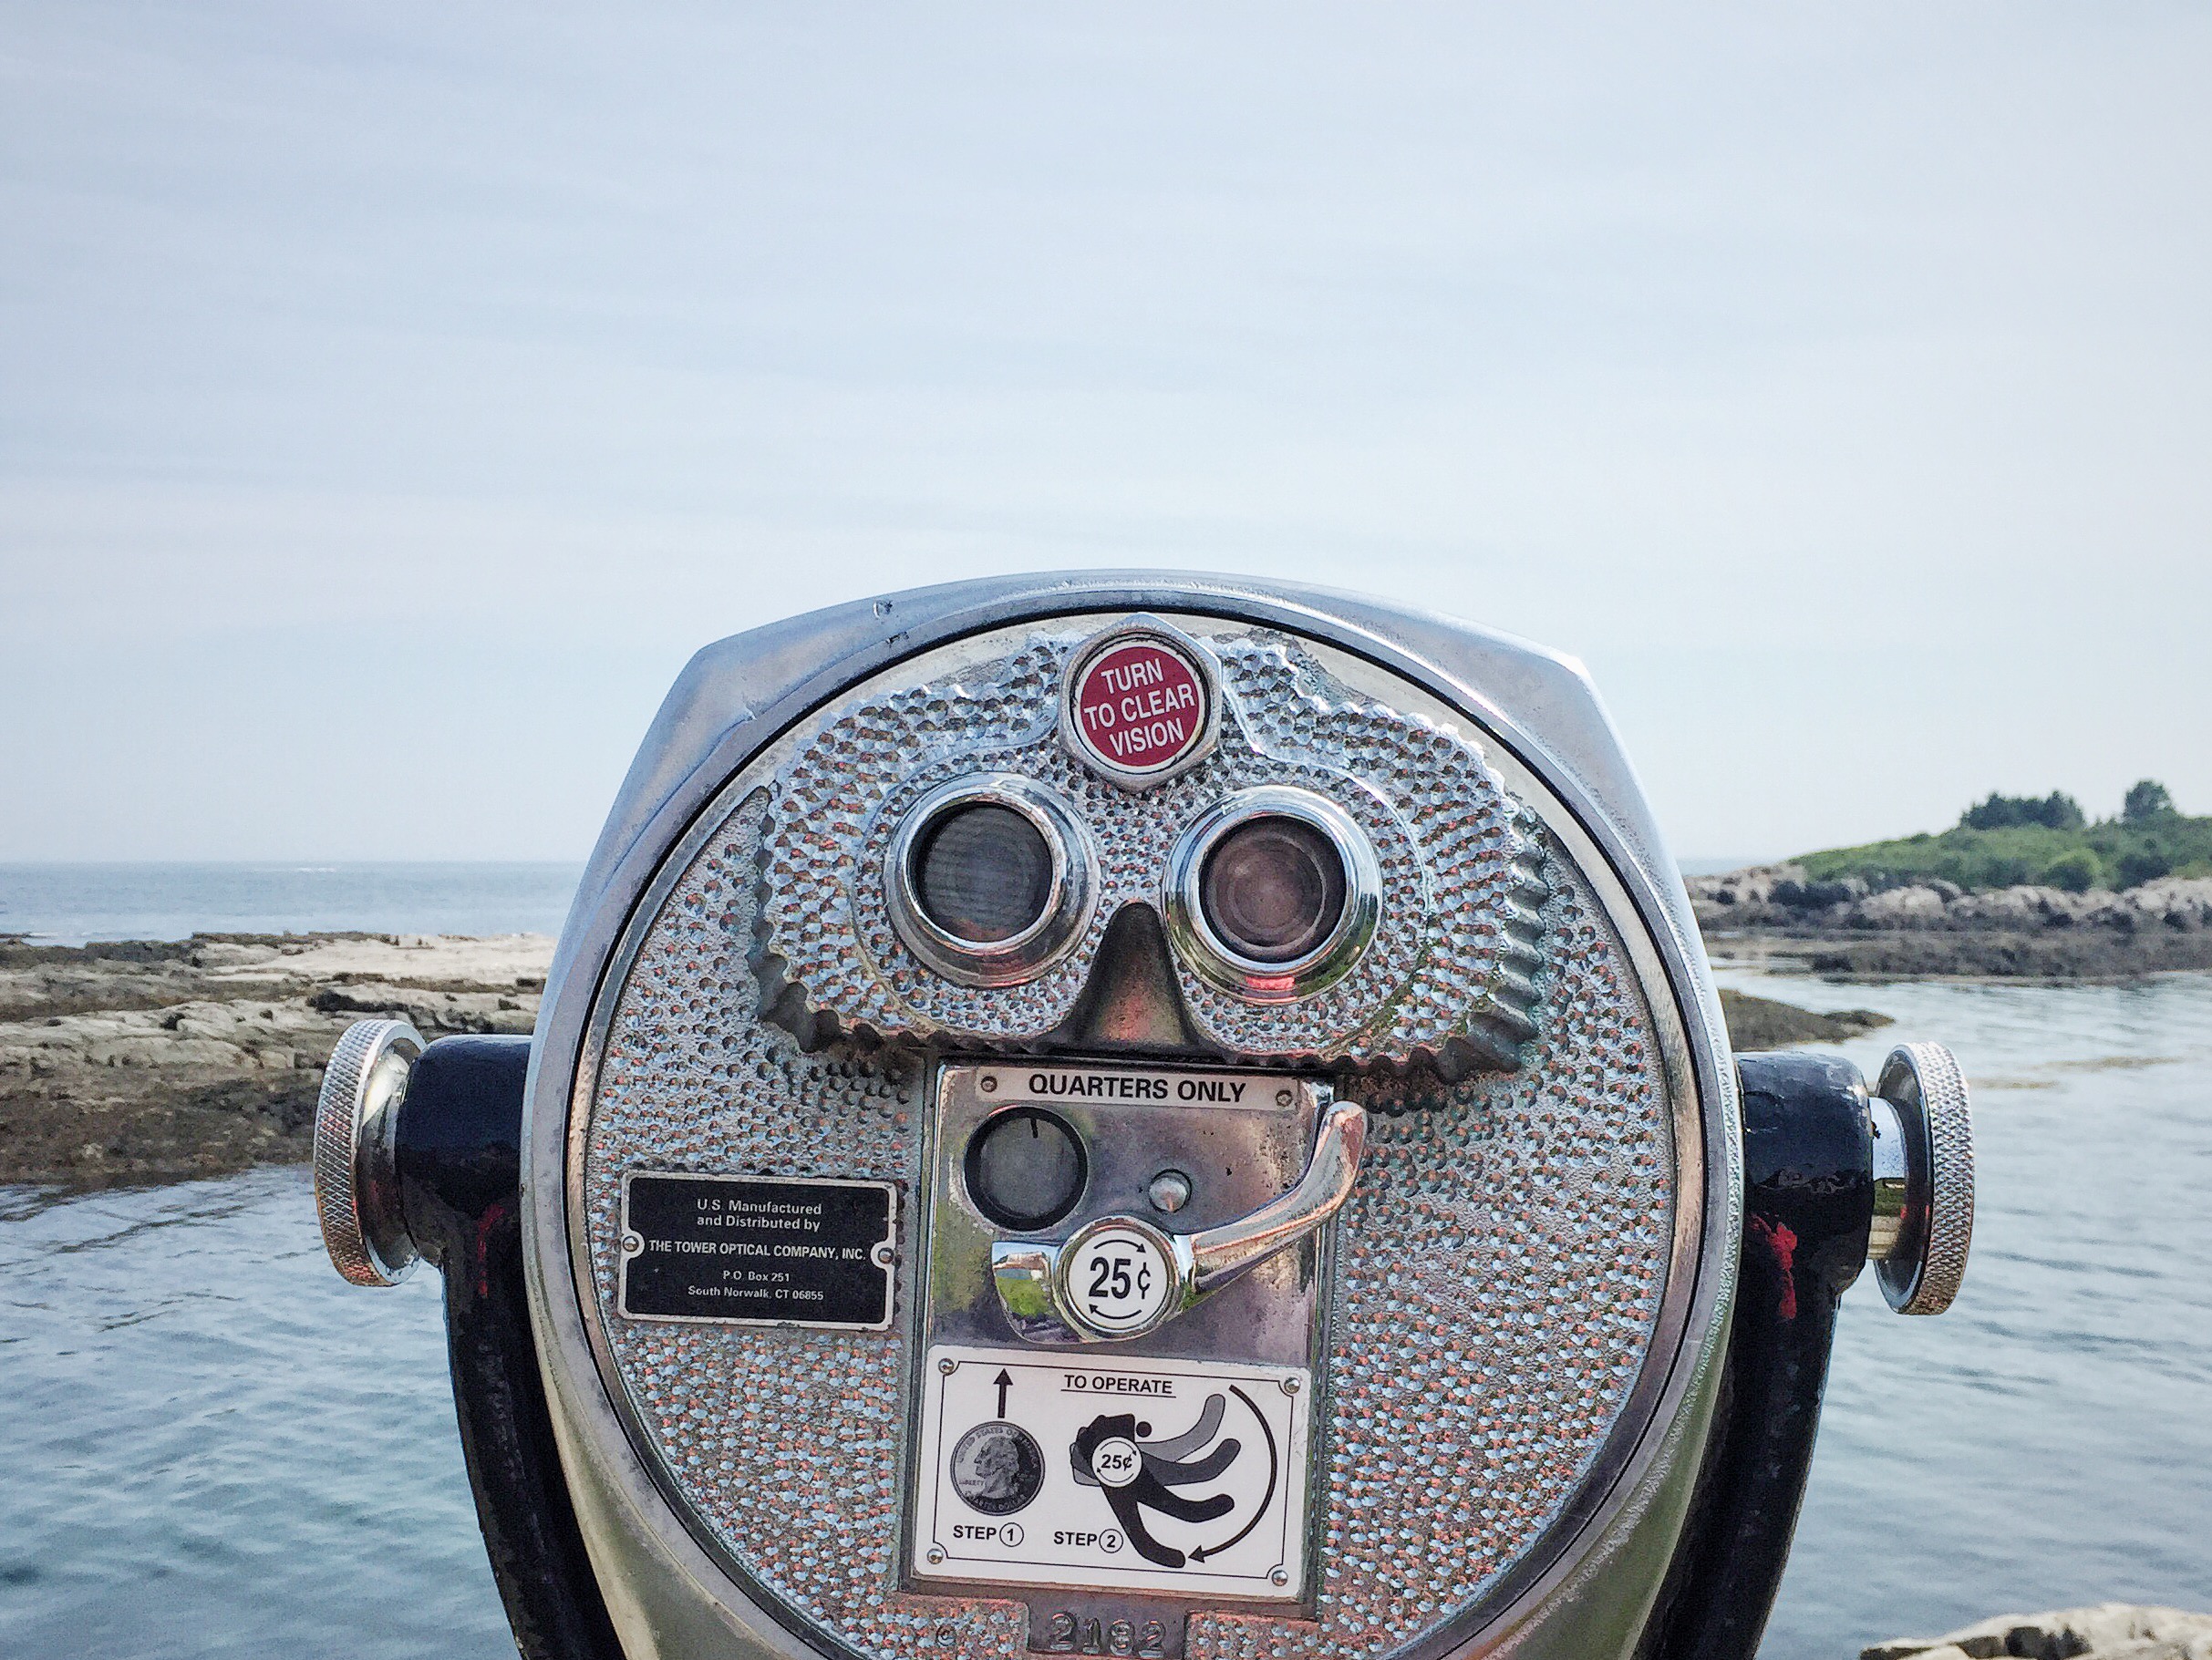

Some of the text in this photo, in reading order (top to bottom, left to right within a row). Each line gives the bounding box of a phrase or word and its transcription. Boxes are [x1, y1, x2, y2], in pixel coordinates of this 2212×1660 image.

[1101, 657, 1164, 694] TURN
[1083, 683, 1195, 731] TO CLEAR
[1109, 717, 1184, 757] VISION
[1028, 1073, 1246, 1103] QUARTERS ONLY
[729, 1200, 822, 1215] Manufactured
[697, 1214, 821, 1232] and Distributed by
[648, 1240, 866, 1261] THE TOWER OPTICAL COMPANY, INC.
[748, 1271, 769, 1282] Box
[770, 1273, 790, 1283] 251
[1088, 1257, 1152, 1300] 25¢
[687, 1285, 721, 1296] South
[774, 1288, 790, 1299] CT
[791, 1290, 824, 1301] 06855
[1063, 1374, 1173, 1395] TO OPERATE
[1101, 1453, 1133, 1471] 25¢
[953, 1525, 997, 1541] STEP
[1053, 1531, 1098, 1546] STEP
